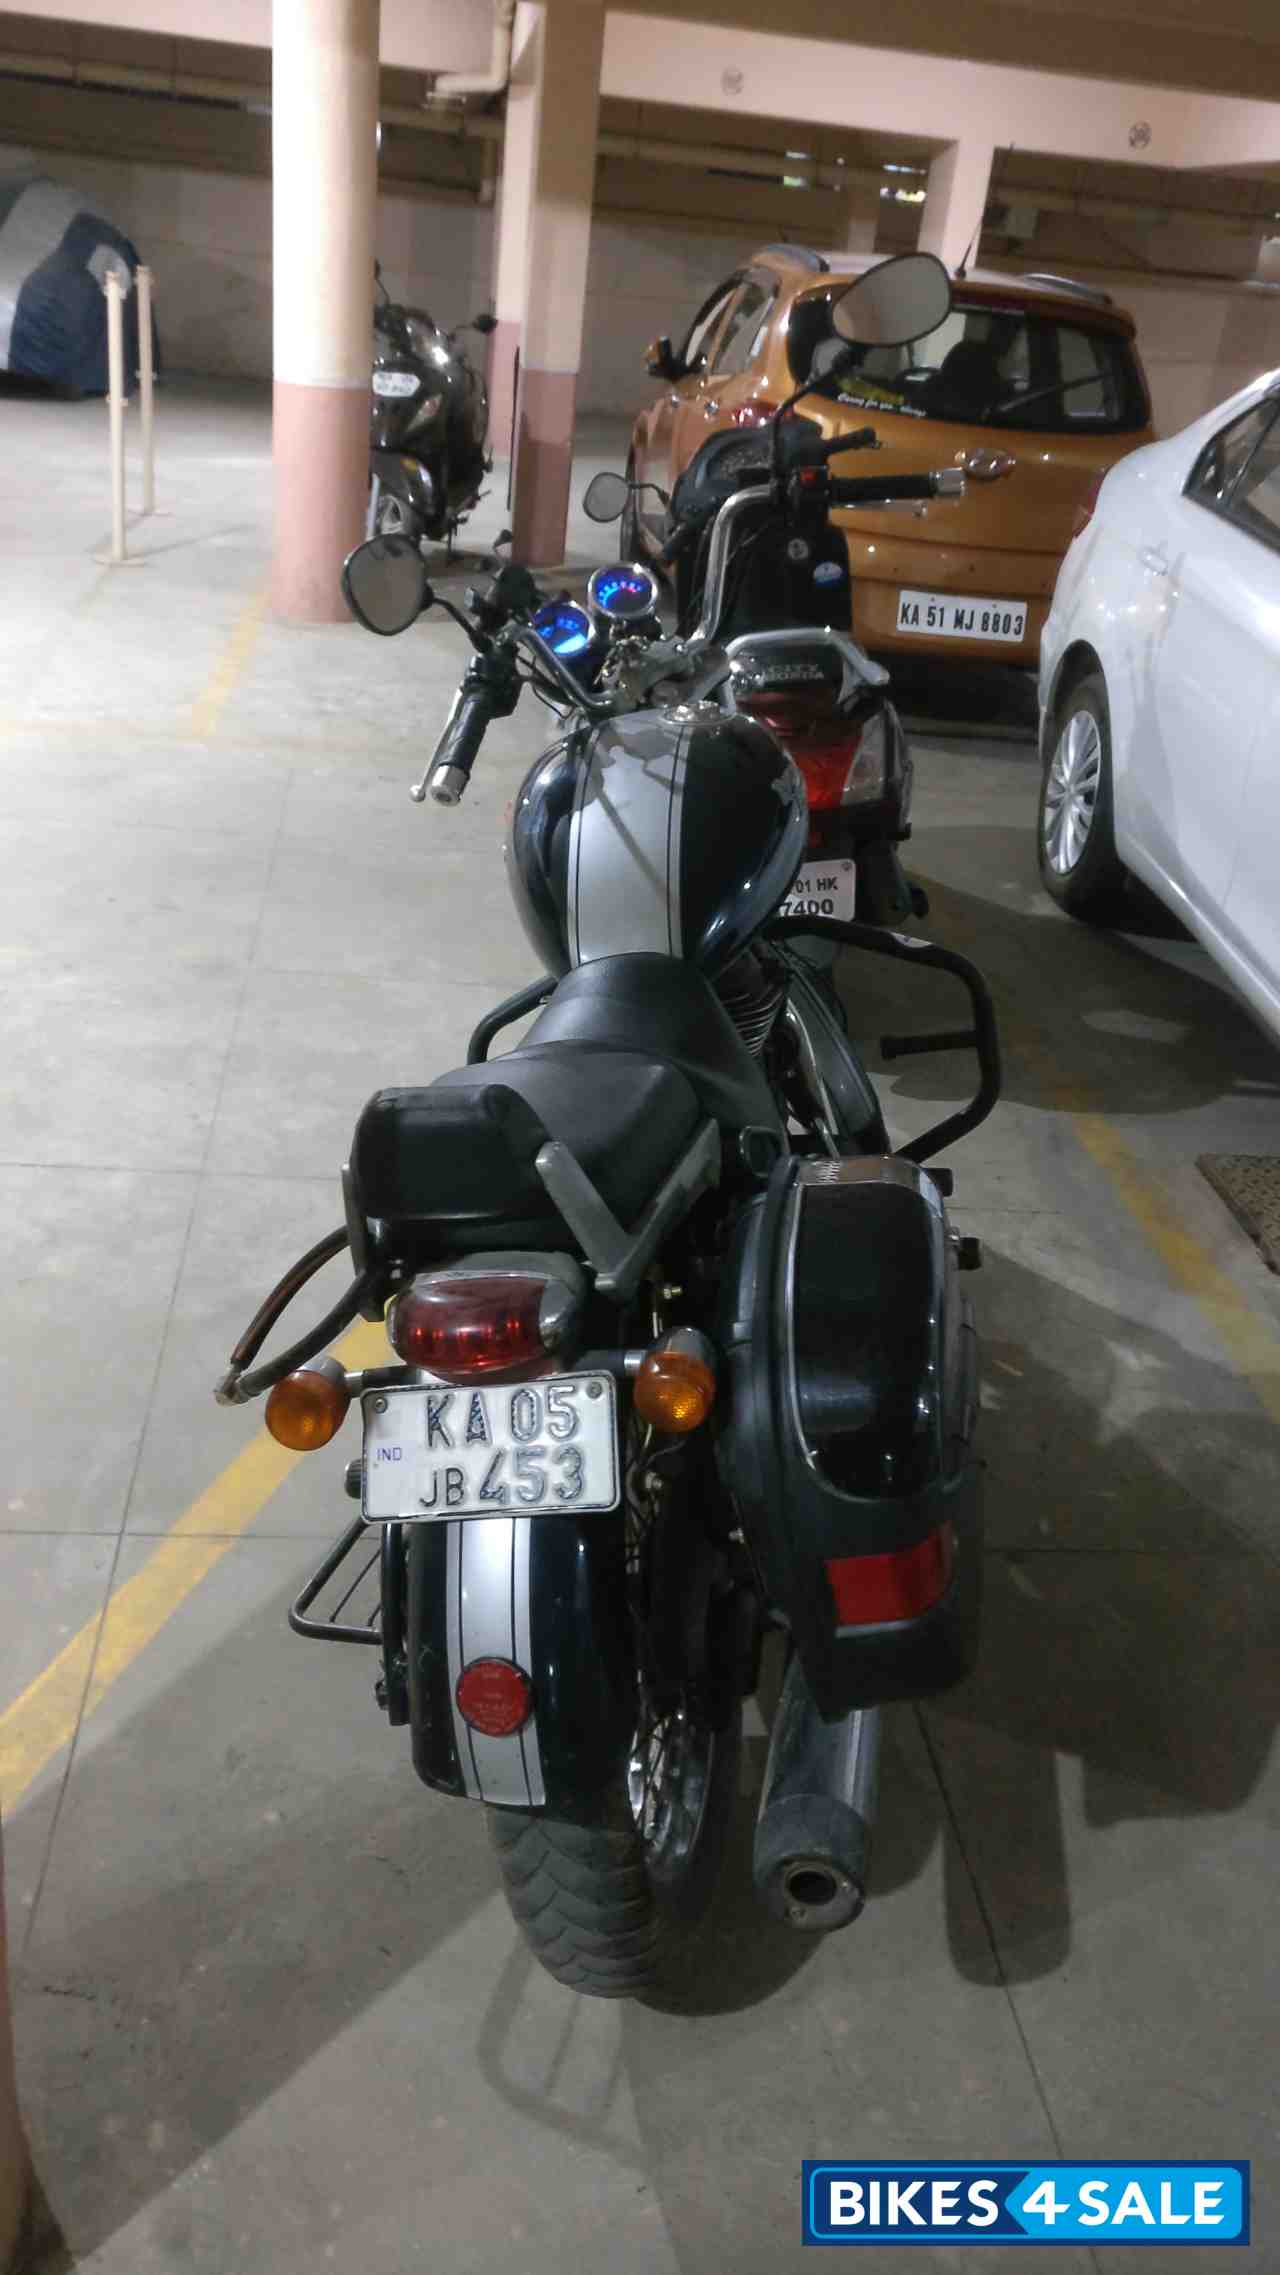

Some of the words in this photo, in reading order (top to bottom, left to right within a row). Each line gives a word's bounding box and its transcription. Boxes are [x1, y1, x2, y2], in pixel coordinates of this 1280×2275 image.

[900, 602, 920, 626] KA
[927, 605, 945, 628] 51
[953, 608, 975, 631] MJ
[981, 611, 1024, 636] 8803
[816, 876, 839, 892] HK
[426, 1390, 492, 1448] KA
[510, 1384, 580, 1443] 05
[376, 1447, 402, 1462] IND
[478, 1445, 585, 1504] 453
